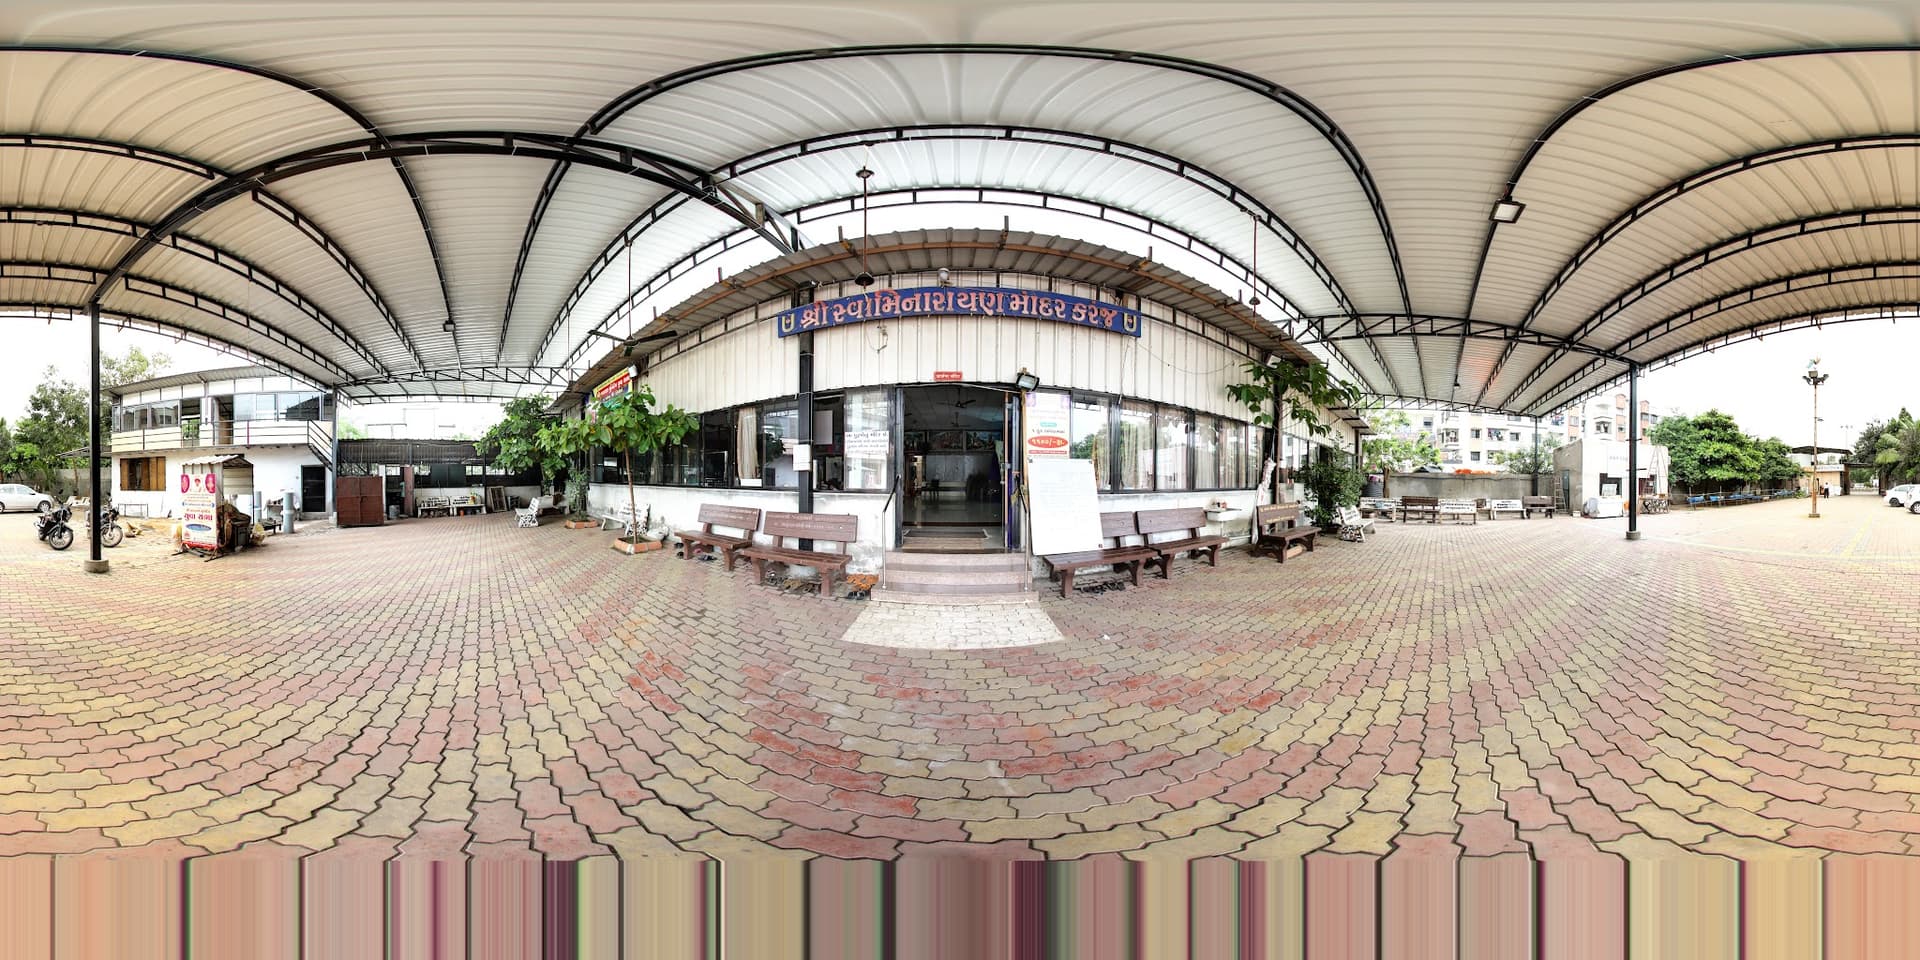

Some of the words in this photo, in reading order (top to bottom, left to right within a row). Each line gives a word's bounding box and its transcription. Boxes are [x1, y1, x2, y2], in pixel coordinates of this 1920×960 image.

[800, 300, 829, 328] શ્રી
[832, 287, 1005, 323] સ્વામિનારાયણ
[1071, 301, 1118, 327] કરંજ
